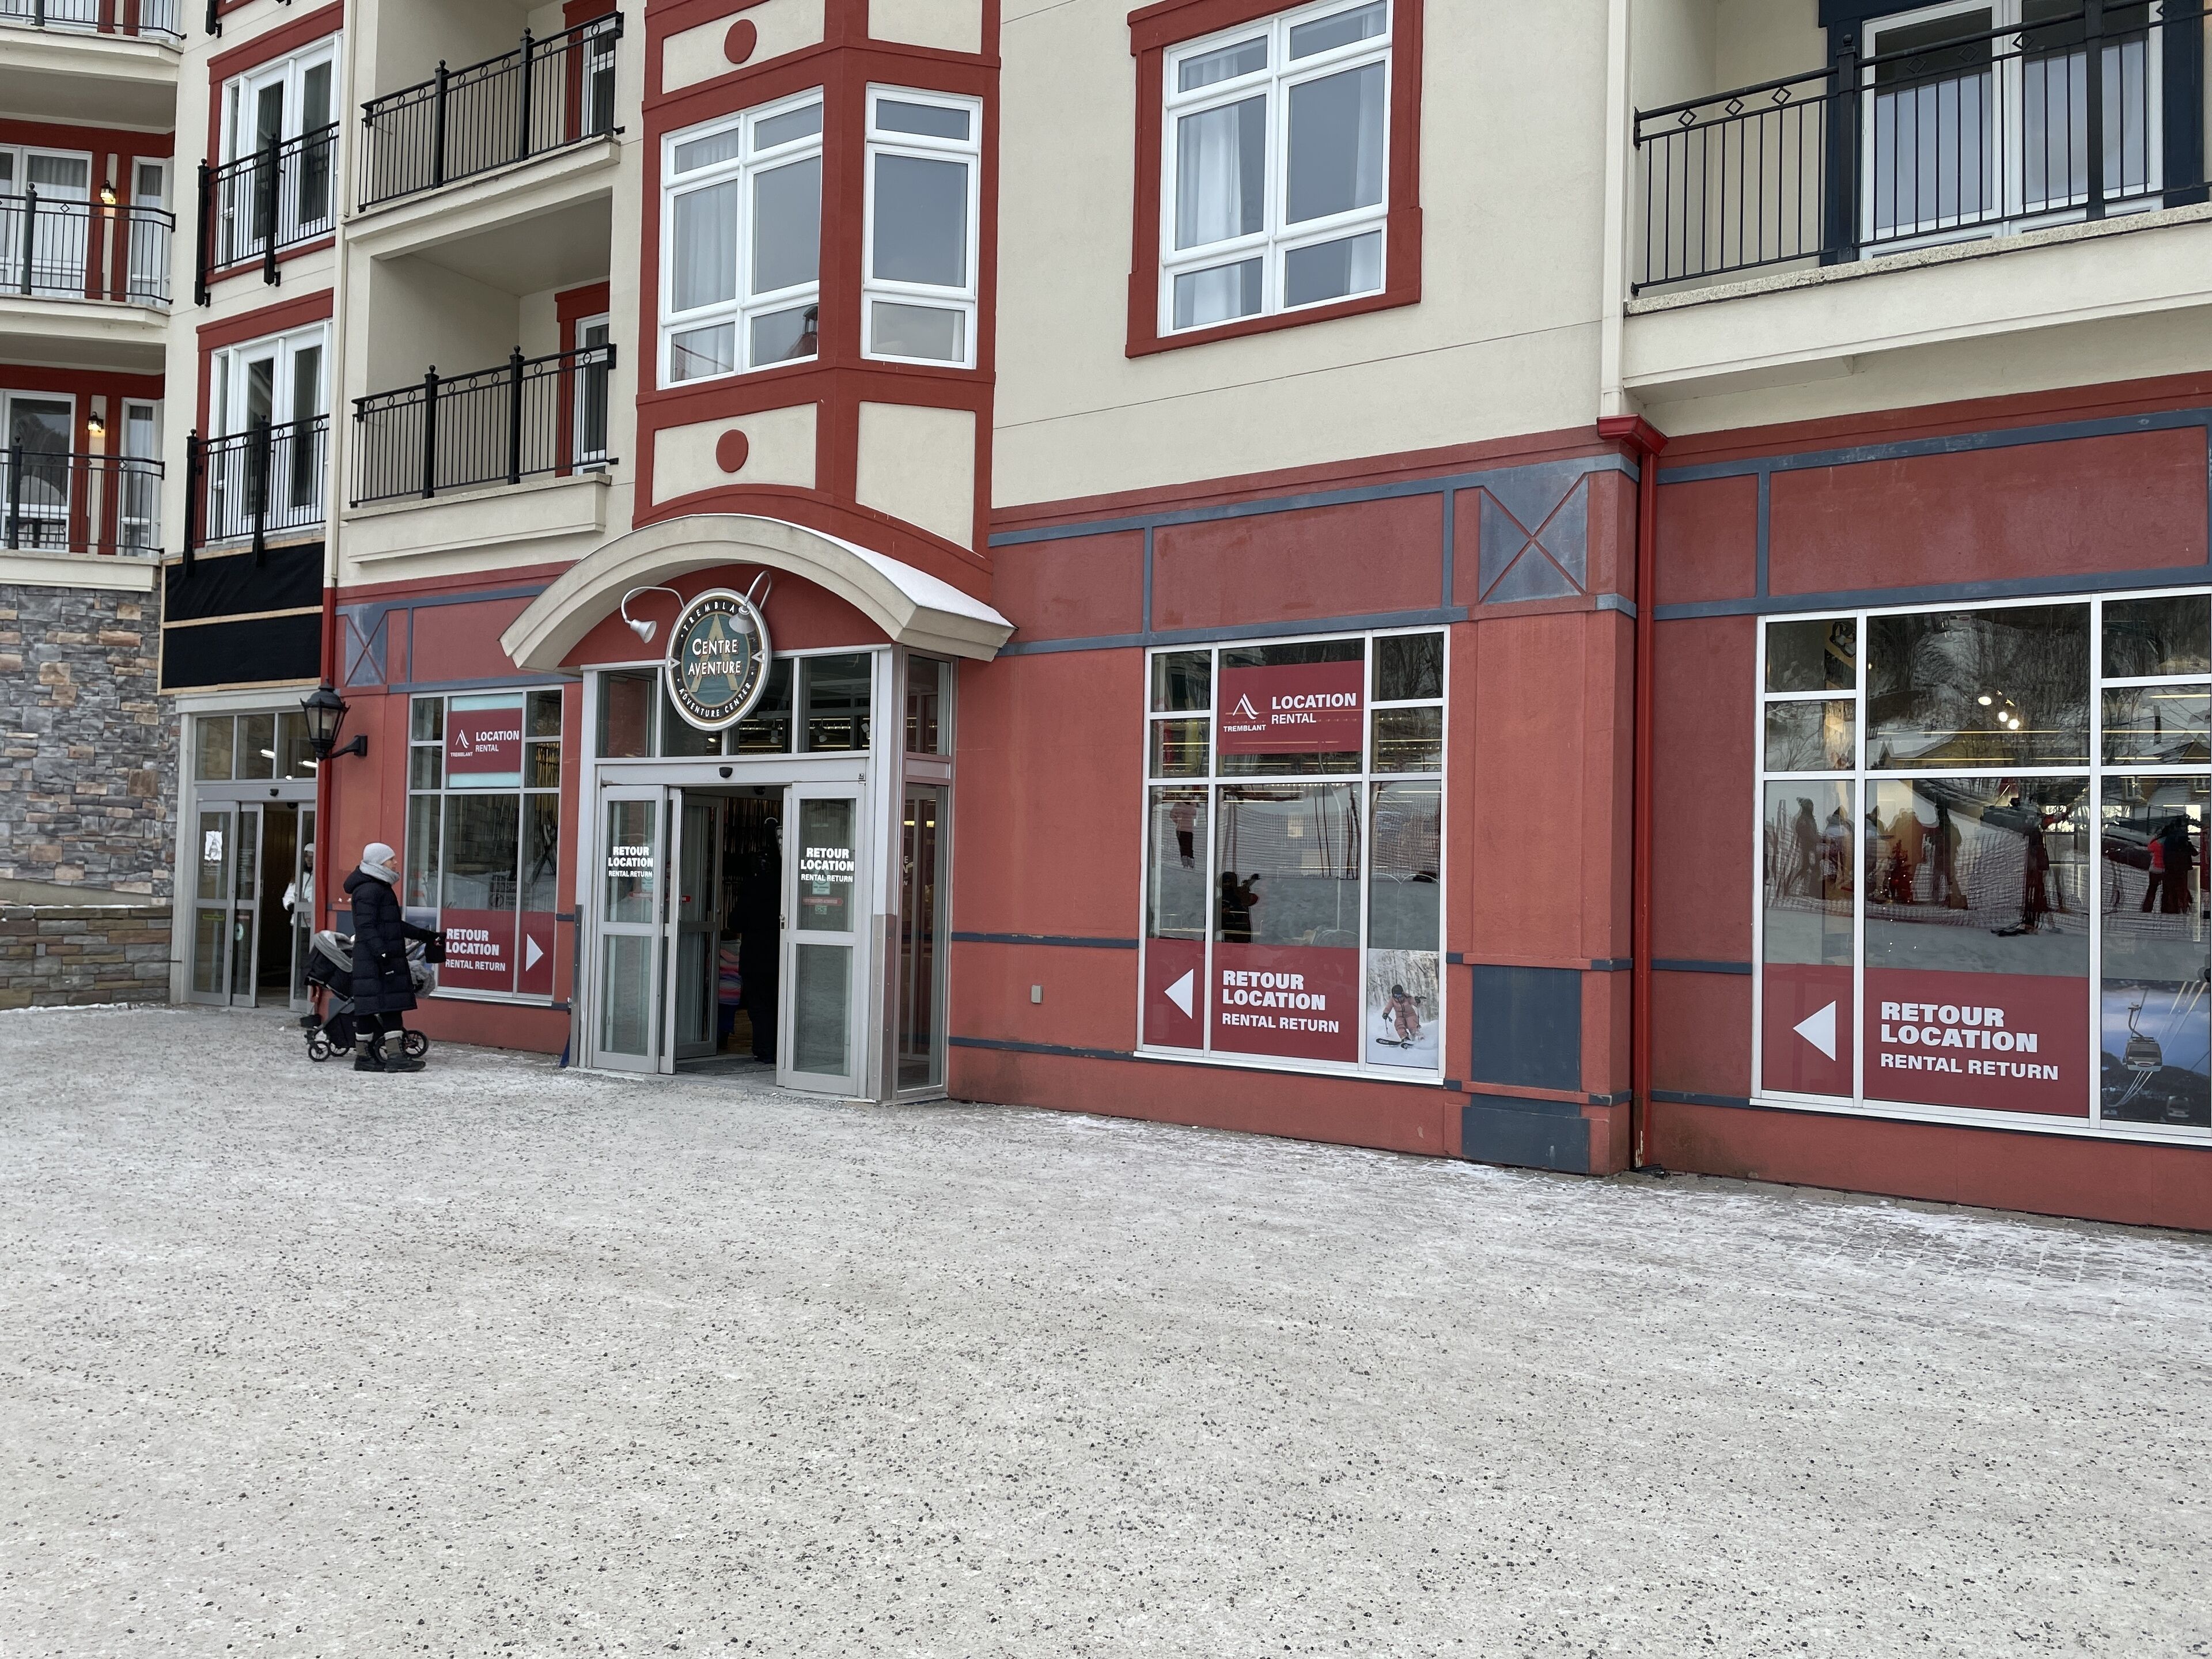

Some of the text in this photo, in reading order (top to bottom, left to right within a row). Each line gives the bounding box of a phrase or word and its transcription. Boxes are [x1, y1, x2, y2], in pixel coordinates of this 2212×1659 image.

[692, 637, 738, 656] CENTRE
[687, 660, 742, 679] AVENTURE
[679, 682, 752, 718] ADVENTURE CENTER
[1271, 692, 1357, 710] LOCATION
[1271, 713, 1317, 725] RENTAL
[1223, 724, 1267, 732] TREMBLANT
[475, 730, 520, 742] LOCATION
[475, 744, 499, 752] RENTAL
[612, 846, 650, 856] RETOUR
[806, 847, 850, 859] RETOUR
[608, 857, 654, 868] LOCATION
[800, 859, 855, 872] LOCATION
[801, 873, 853, 882] RENTAL RETURN
[446, 928, 489, 942] RETOUR
[445, 941, 500, 956] LOCATION
[445, 959, 506, 972] RENTAL RETURN
[1222, 969, 1304, 990] RETOUR
[1222, 988, 1326, 1011] LOCATION
[1881, 1001, 2005, 1027] RETOUR
[1222, 1013, 1339, 1033] RENTAL RETURN
[1881, 1024, 2037, 1053] LOCATION
[1880, 1053, 2059, 1081] RENTAL RETURN
